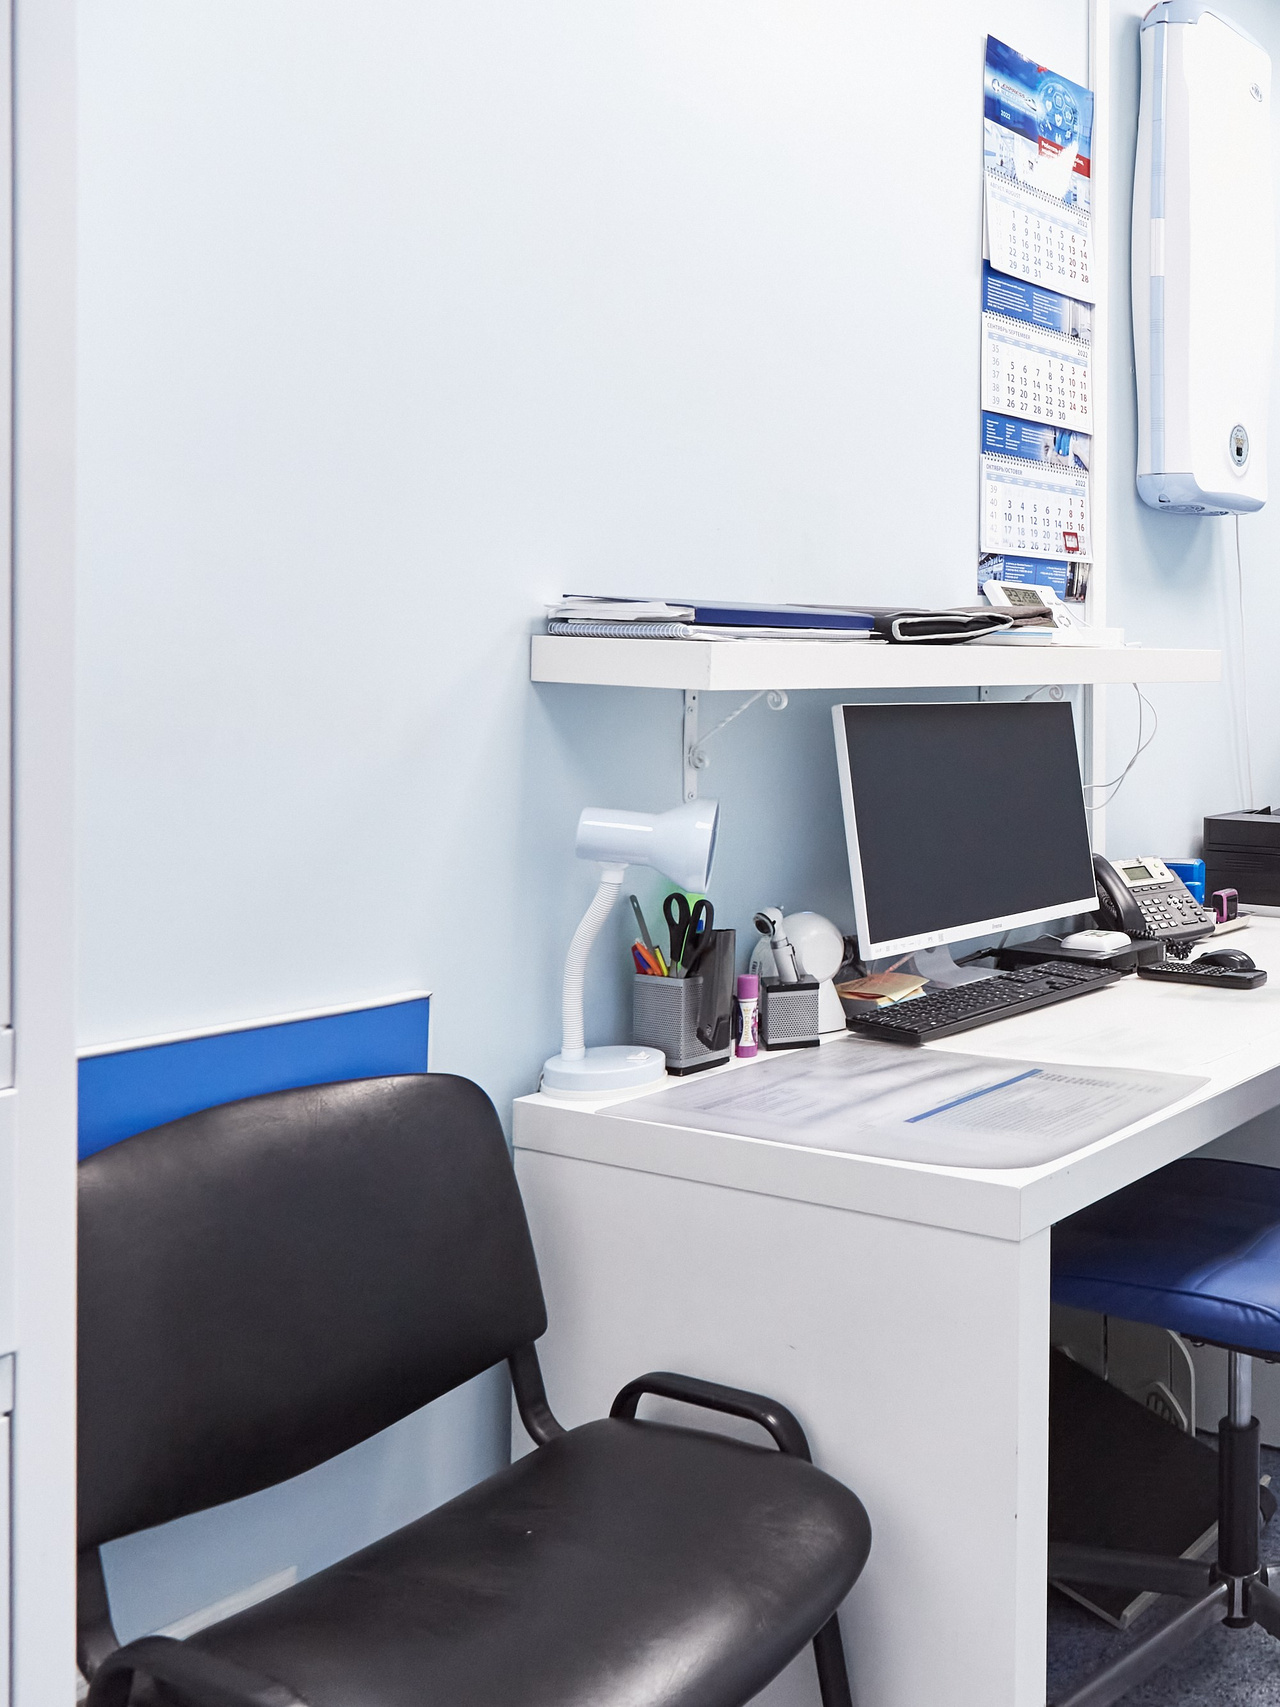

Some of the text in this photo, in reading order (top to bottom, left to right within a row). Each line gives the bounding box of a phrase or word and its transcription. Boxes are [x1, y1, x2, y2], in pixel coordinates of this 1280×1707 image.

[1012, 223, 1087, 259] 8 9 10 11 12 13 14
[1009, 234, 1087, 271] 15 16 17 18 19 20 21
[1009, 247, 1089, 283] 22 23 24 25 26 27 28
[1009, 260, 1041, 279] 29 30 31
[1010, 361, 1014, 370] 5
[1023, 365, 1027, 374] 6
[1036, 369, 1040, 377] 7
[1048, 372, 1052, 380] 8
[1060, 375, 1064, 383] 9
[1069, 378, 1076, 387] 10
[1080, 381, 1086, 390] 11
[1060, 363, 1064, 372] 2
[1072, 367, 1075, 375] 3
[1083, 370, 1086, 378] 4
[1007, 373, 1015, 383] 12
[1020, 376, 1027, 386] 13
[1033, 380, 1041, 389] 14
[1045, 384, 1052, 393] 15
[1058, 387, 1065, 396] 16
[1069, 390, 1076, 398] 17
[1081, 393, 1087, 402] 18
[1007, 386, 1015, 395] 19
[1020, 389, 1028, 399] 20
[1033, 392, 1040, 402] 21
[1045, 396, 1053, 405] 22
[1058, 399, 1065, 408] 23
[1069, 402, 1076, 411] 24
[1081, 405, 1087, 414] 25
[1007, 398, 1015, 408] 26
[1020, 402, 1028, 411] 27
[1033, 405, 1041, 415] 28
[1046, 408, 1053, 417] 29
[1059, 411, 1065, 420] 30
[1075, 479, 1086, 487] 2022
[1008, 500, 1012, 509] 3
[1021, 502, 1024, 511] 4
[1033, 504, 1037, 512] 5
[1045, 506, 1050, 515] 6
[1058, 508, 1061, 516] 7
[1069, 510, 1073, 518] 8
[1080, 511, 1084, 519] 9
[1080, 499, 1084, 508] 2
[1004, 512, 1012, 522] 10
[1017, 514, 1024, 523] 11
[1030, 516, 1037, 525] 12
[1043, 518, 1050, 527] 13
[1055, 520, 1062, 528] 14
[1066, 522, 1073, 530] 15
[1078, 523, 1085, 532] 16
[1004, 525, 1012, 534] 17
[1017, 527, 1025, 536] 18
[1030, 528, 1038, 538] 19
[1043, 530, 1050, 539] 20
[1054, 532, 1061, 541] 21
[1017, 539, 1025, 549] 25
[1030, 541, 1039, 550] 26
[1043, 543, 1050, 552] 27
[1055, 545, 1063, 553] 28
